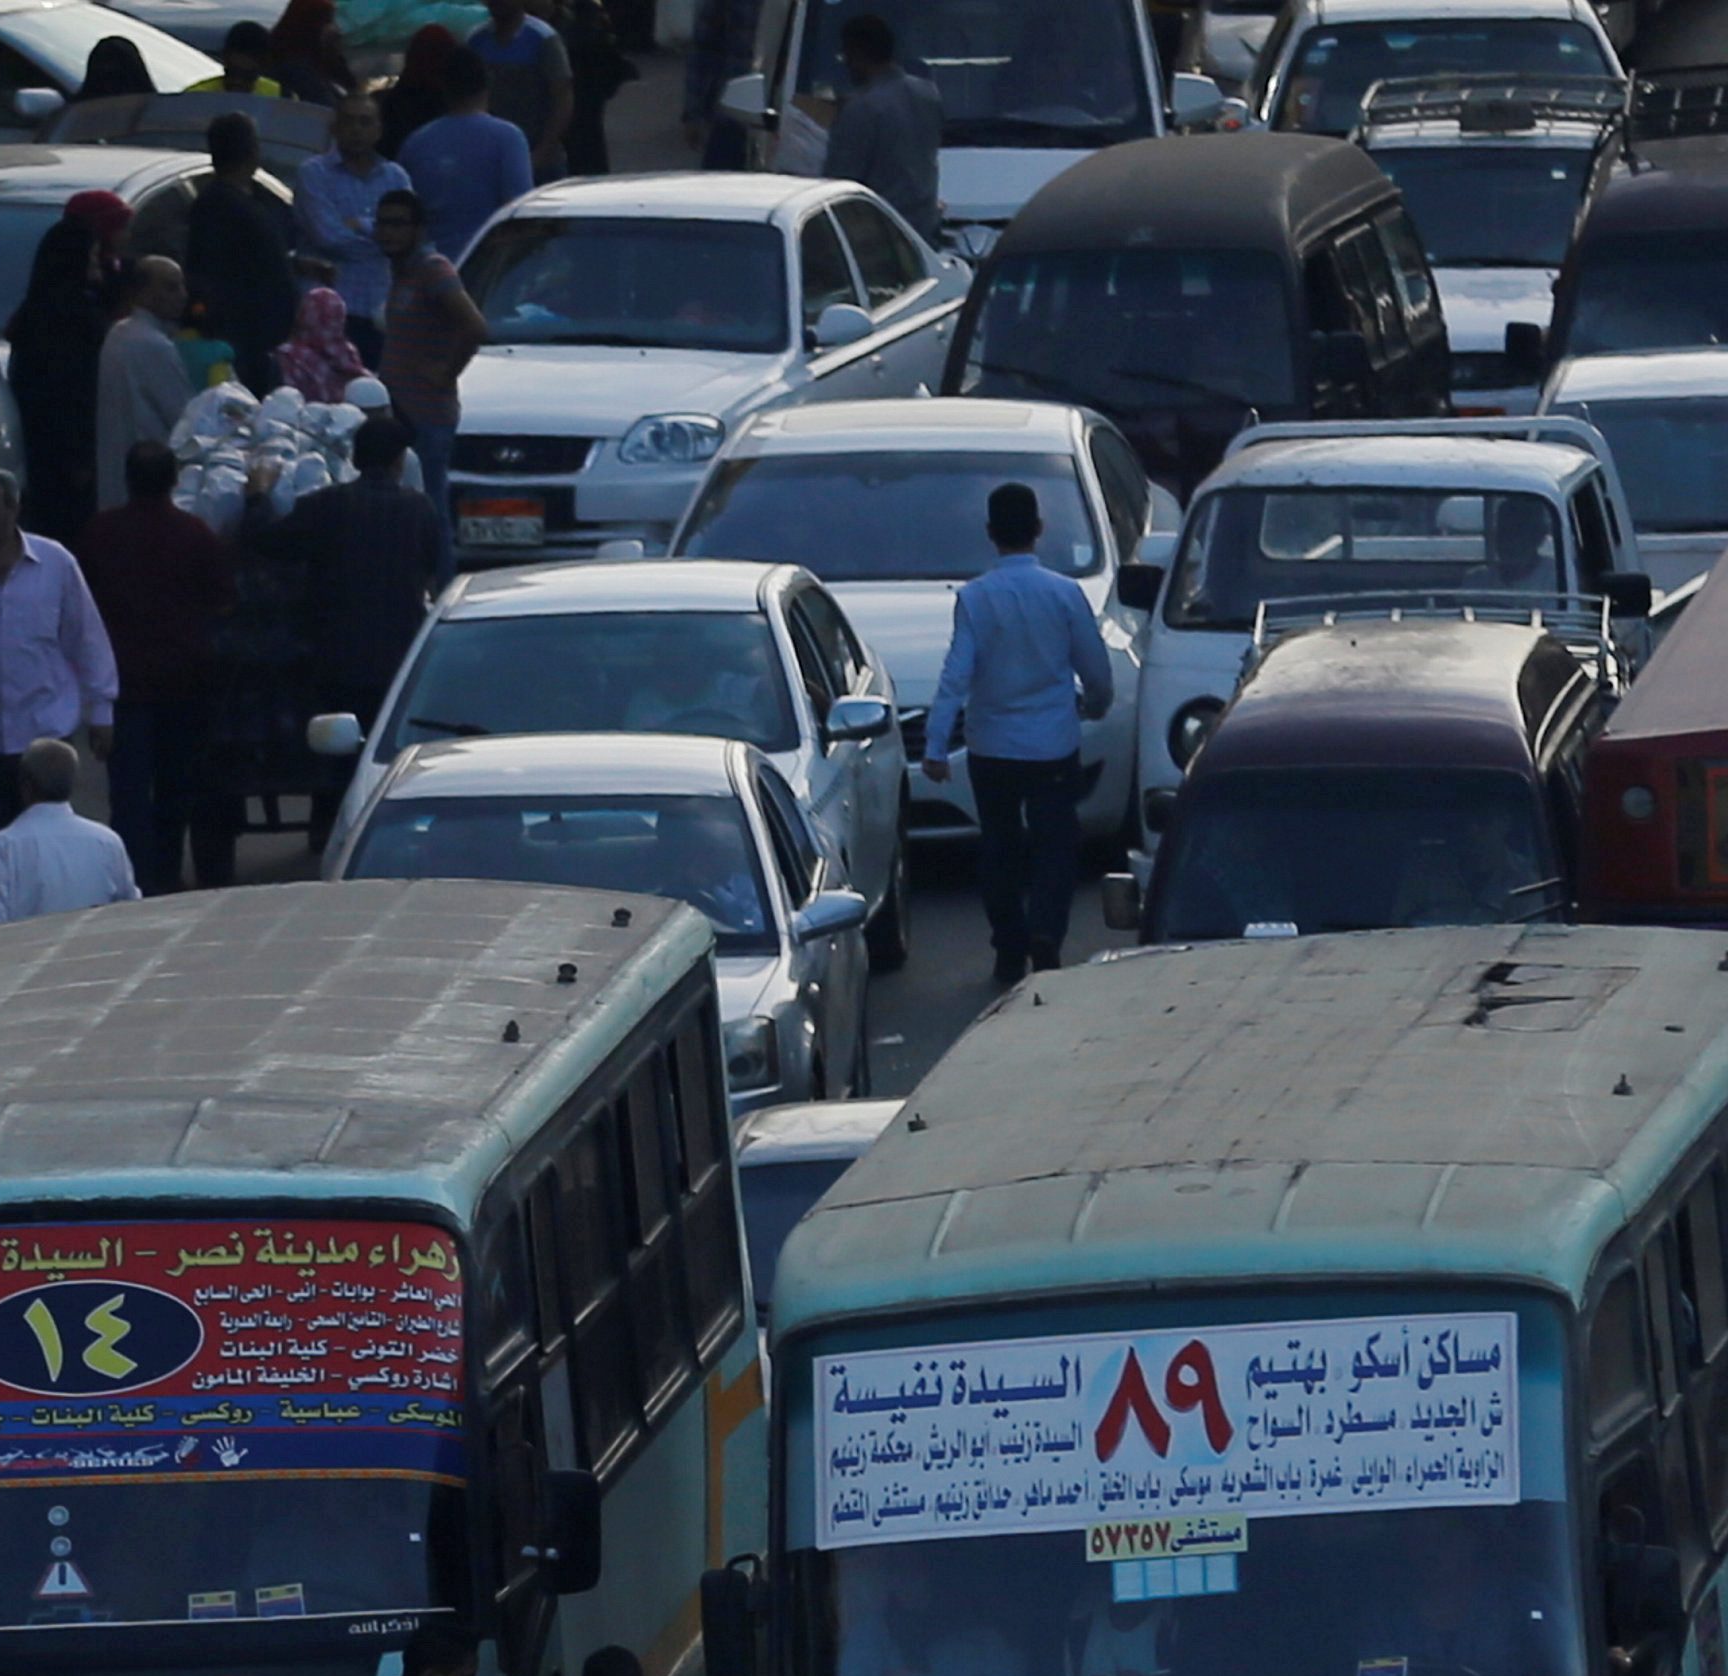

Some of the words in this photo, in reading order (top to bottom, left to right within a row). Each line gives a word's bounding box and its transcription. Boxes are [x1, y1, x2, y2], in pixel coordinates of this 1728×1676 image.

[0, 1237, 123, 1281] السيدة
[164, 1232, 245, 1277] نصر
[253, 1228, 359, 1278] مدينة
[368, 1233, 460, 1281] زهراء
[23, 1292, 139, 1383] ١٤
[219, 1340, 283, 1362] البنات
[287, 1339, 329, 1361] كلية
[255, 1365, 325, 1389] الخليفة
[1246, 1340, 1327, 1400] بهتيم
[1417, 1329, 1502, 1391] مساكن
[829, 1360, 944, 1425] نفيسة
[949, 1354, 1083, 1419] السيدة
[1095, 1339, 1234, 1464] ٨٩
[31, 1408, 102, 1429] البنات
[108, 1404, 155, 1428] كلية
[280, 1399, 362, 1424] عباسية
[1247, 1404, 1311, 1451] السواح
[1325, 1400, 1397, 1444] مسطرد
[1411, 1395, 1476, 1443] الجديد
[871, 1428, 914, 1464] محكمة
[923, 1423, 969, 1472] الريش
[999, 1420, 1033, 1466] زينب
[1033, 1420, 1083, 1463] السيدة
[1021, 1477, 1052, 1517] ماهر
[1135, 1470, 1162, 1511] باب
[1276, 1462, 1302, 1502] باب
[1309, 1456, 1343, 1498] غمرة
